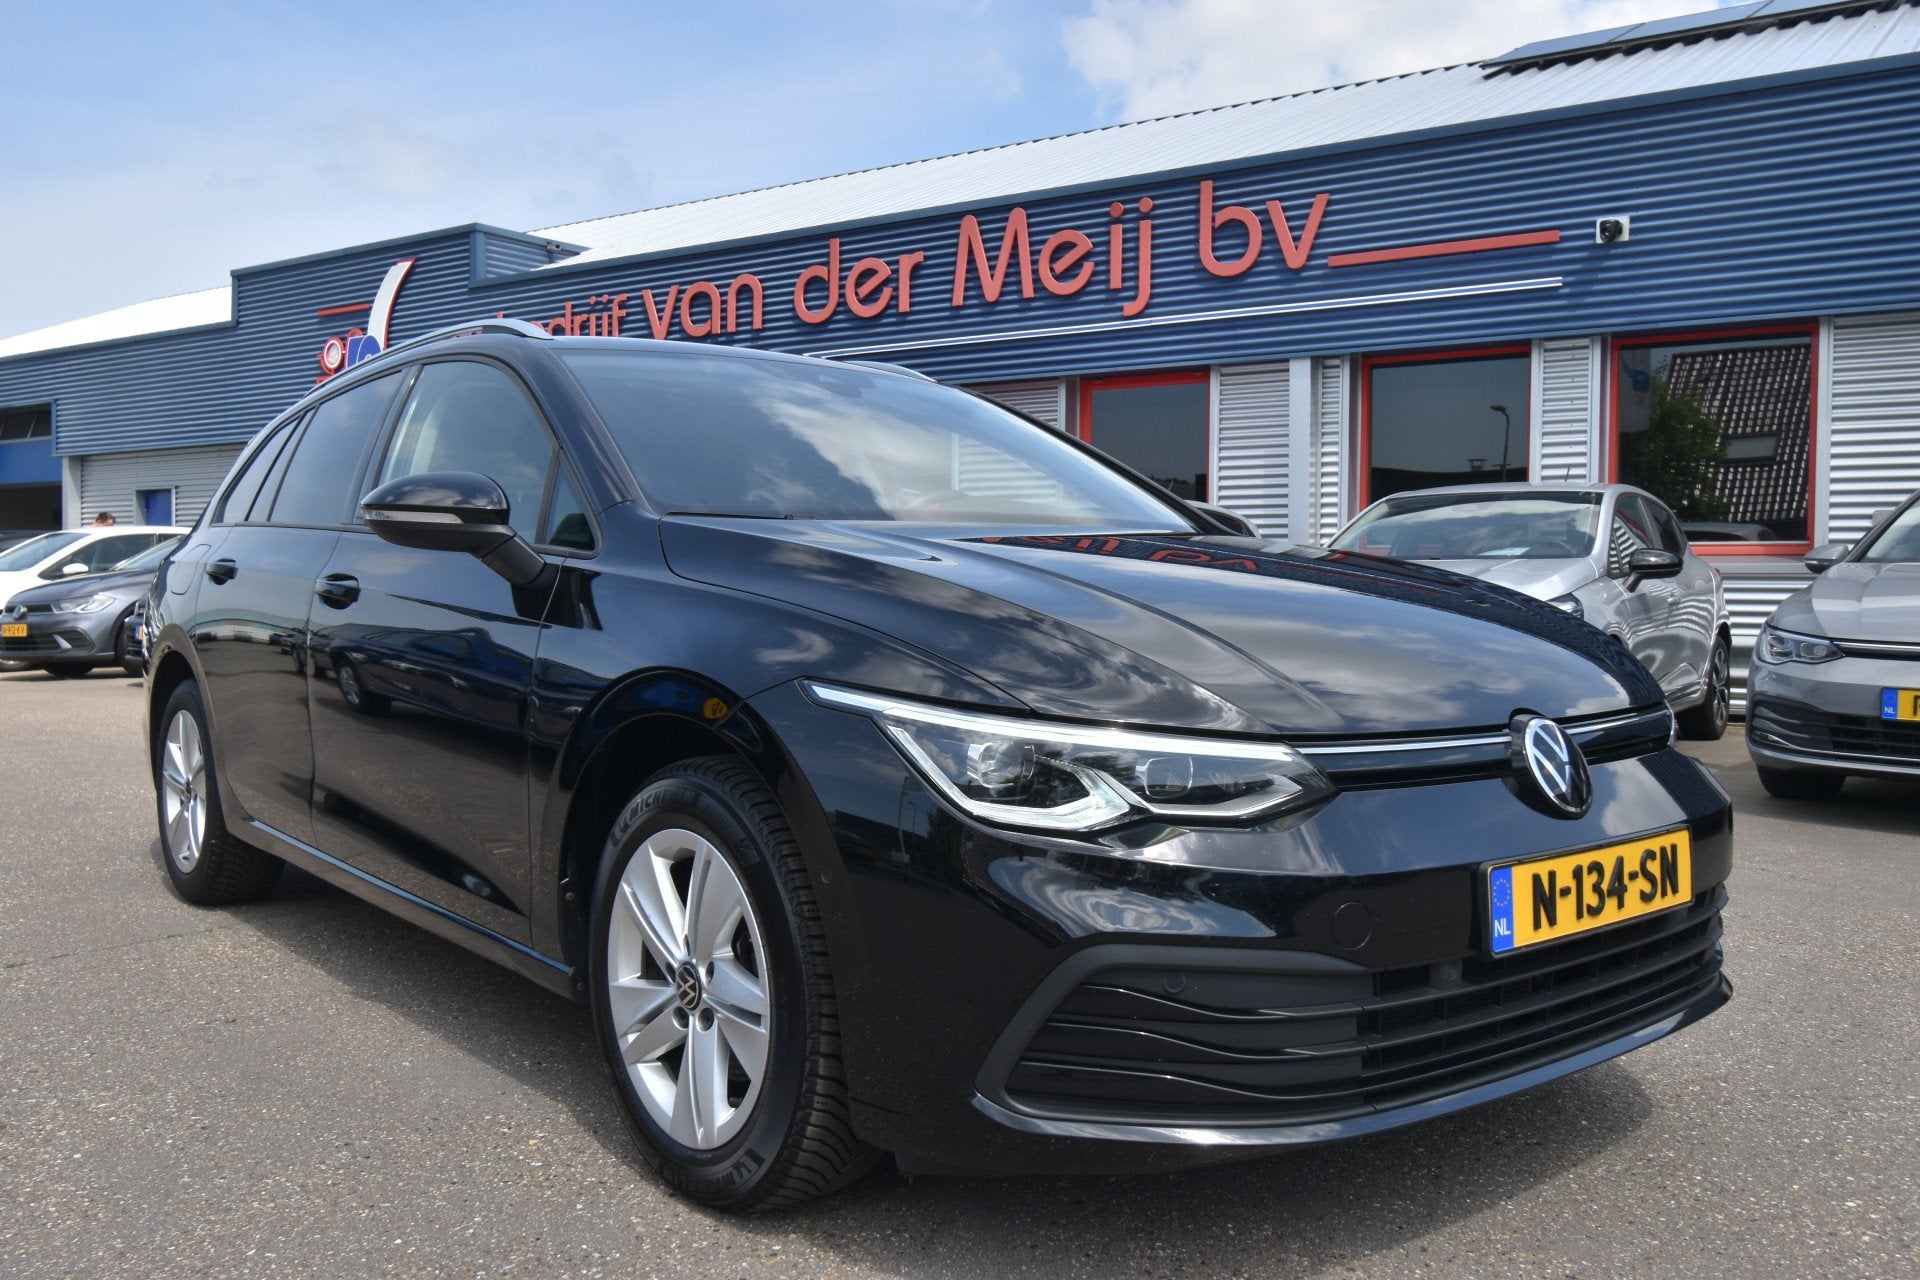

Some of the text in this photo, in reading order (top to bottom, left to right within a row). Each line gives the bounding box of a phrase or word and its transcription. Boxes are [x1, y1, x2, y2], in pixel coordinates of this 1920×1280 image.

[497, 179, 1330, 340] drijf van der Meij bv
[1884, 706, 1896, 714] NL
[1532, 843, 1679, 931] N-134-SN
[1494, 917, 1511, 937] NL
